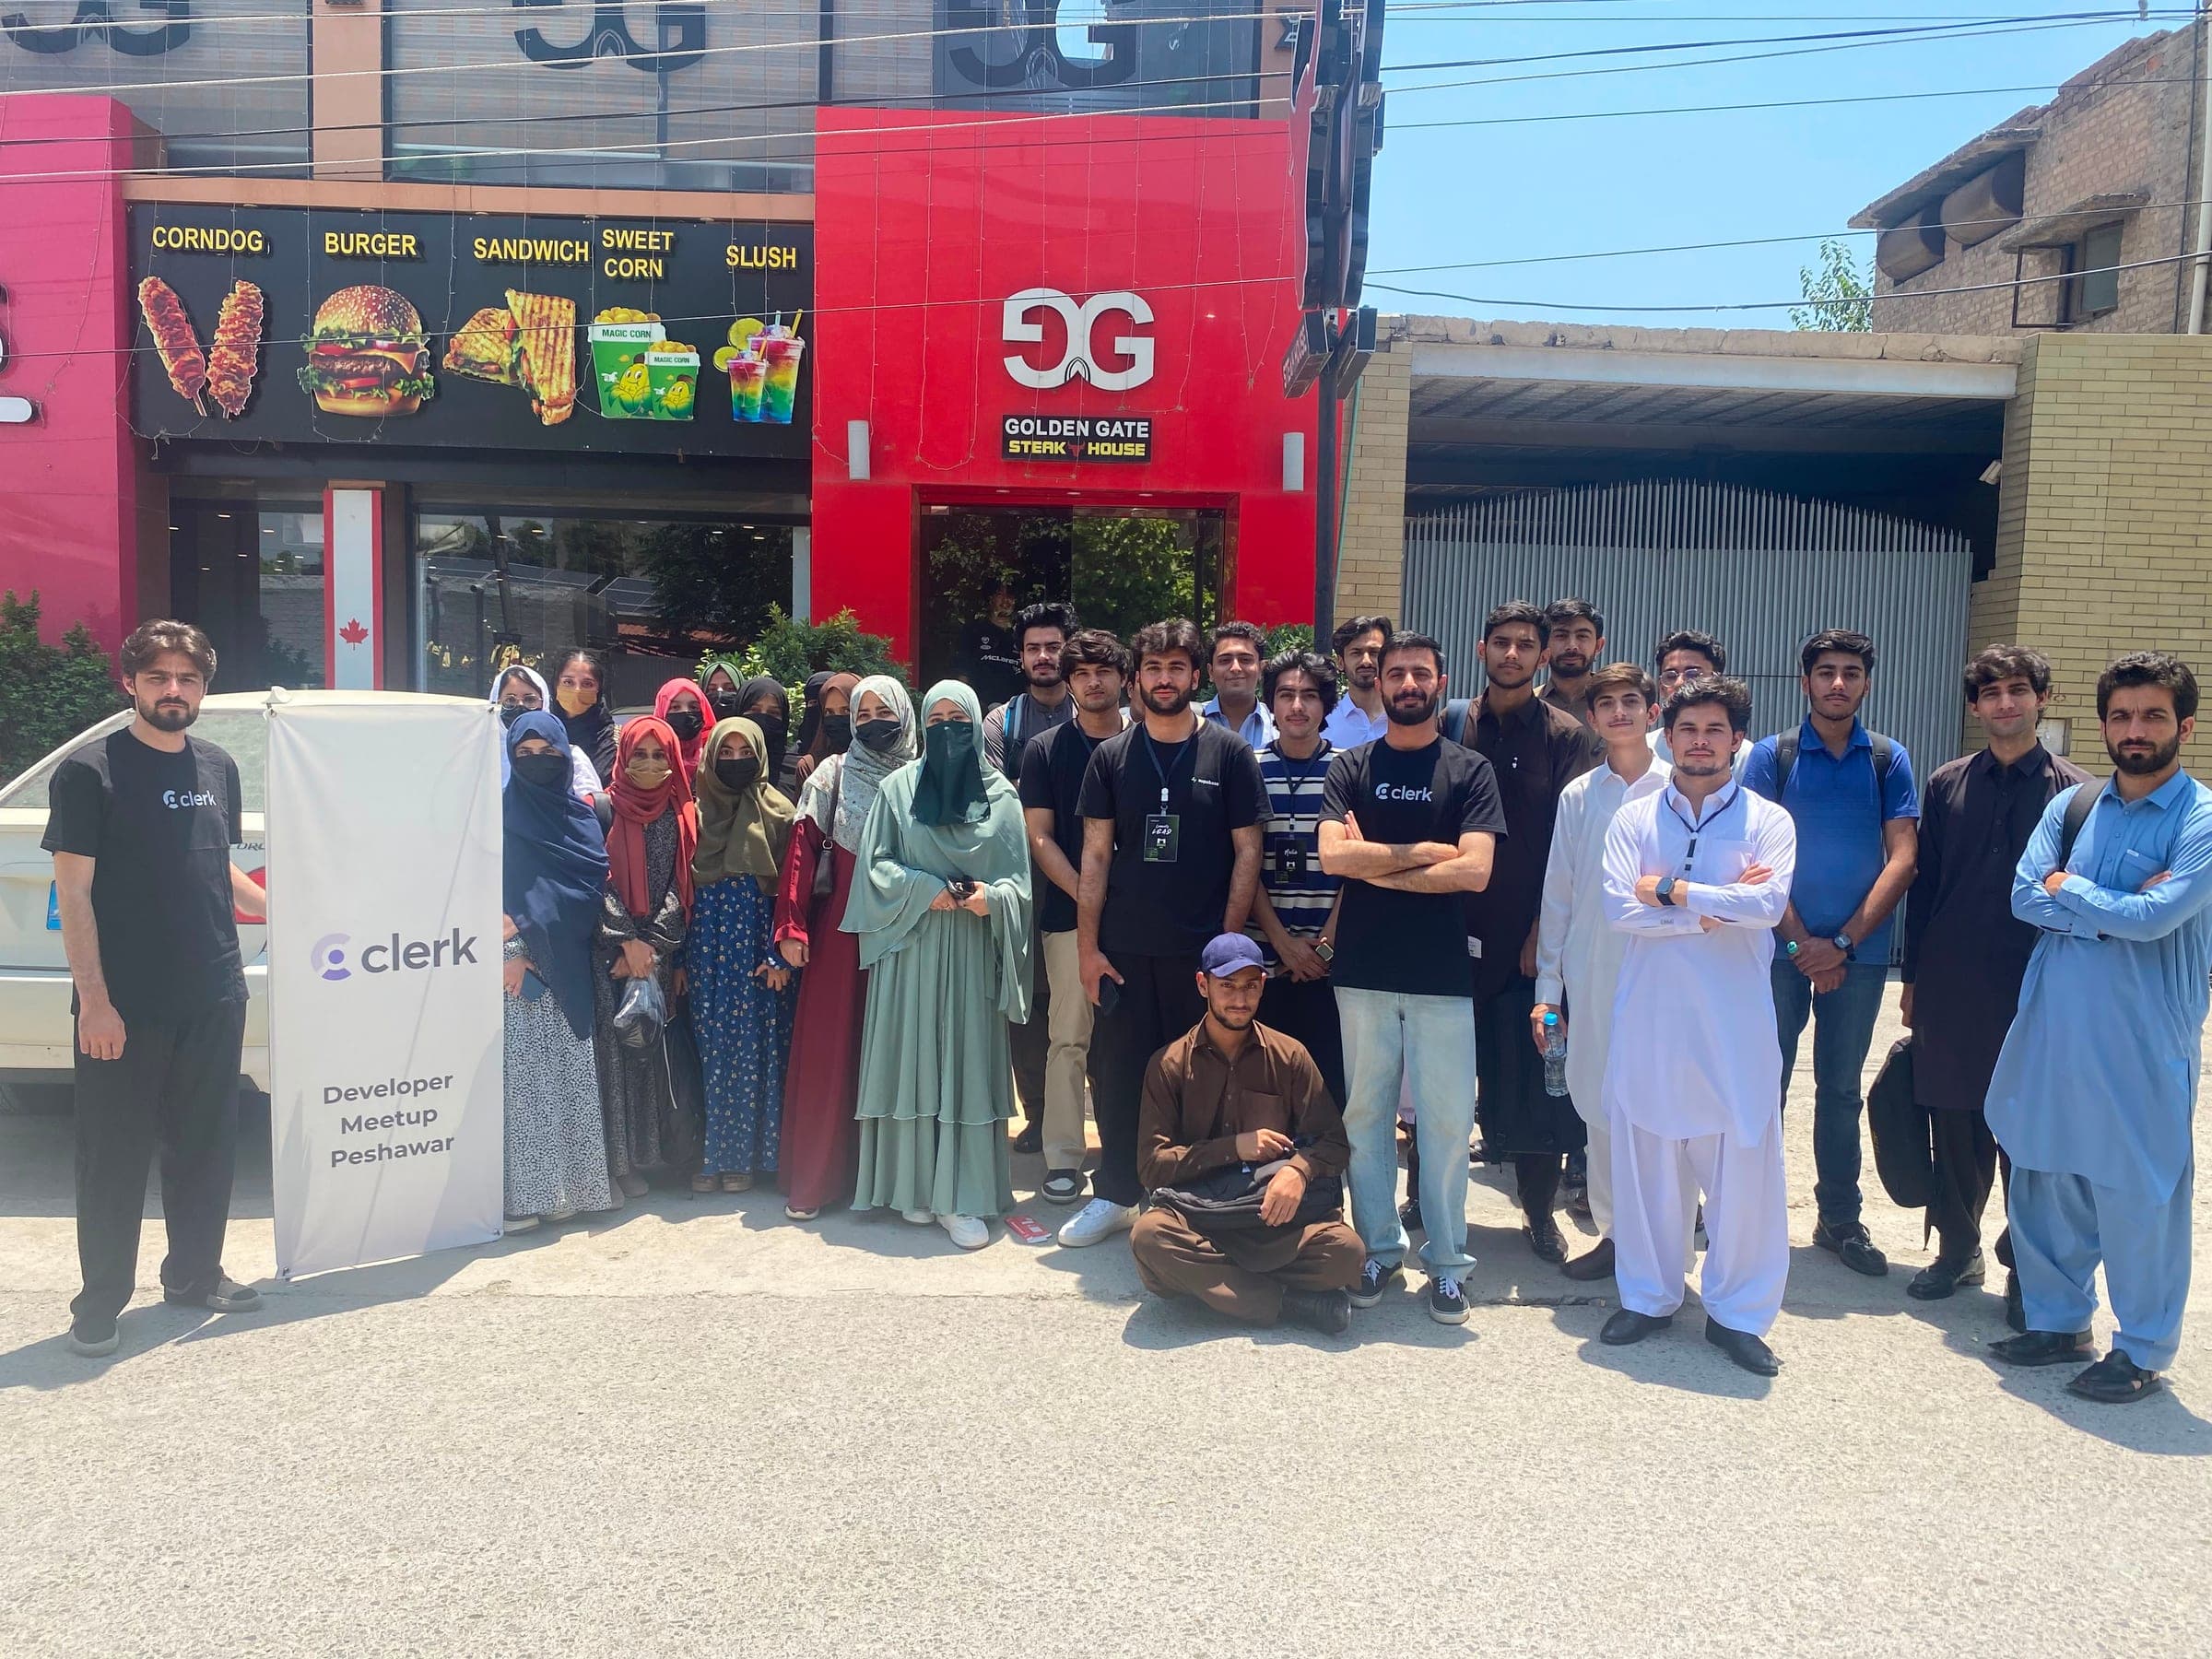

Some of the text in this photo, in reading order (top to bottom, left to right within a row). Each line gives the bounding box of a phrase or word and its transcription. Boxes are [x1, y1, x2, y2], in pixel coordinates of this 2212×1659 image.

[152, 226, 264, 252] CORNDOG
[325, 232, 418, 255] BURGER
[473, 237, 590, 262] SANDWICH
[602, 229, 674, 251] SWEET
[604, 258, 664, 277] CORN
[726, 244, 796, 268] SLUSH
[602, 329, 652, 338] MAGIC CORN
[1005, 418, 1149, 438] GOLDEN GATE
[1008, 440, 1146, 456] STEAK HOUSE
[180, 789, 218, 806] clerk
[1391, 784, 1433, 802] clerk
[360, 927, 478, 973] clerk
[324, 1075, 453, 1105] Developer
[341, 1108, 438, 1135] Meetup
[331, 1135, 454, 1168] Peshawar
